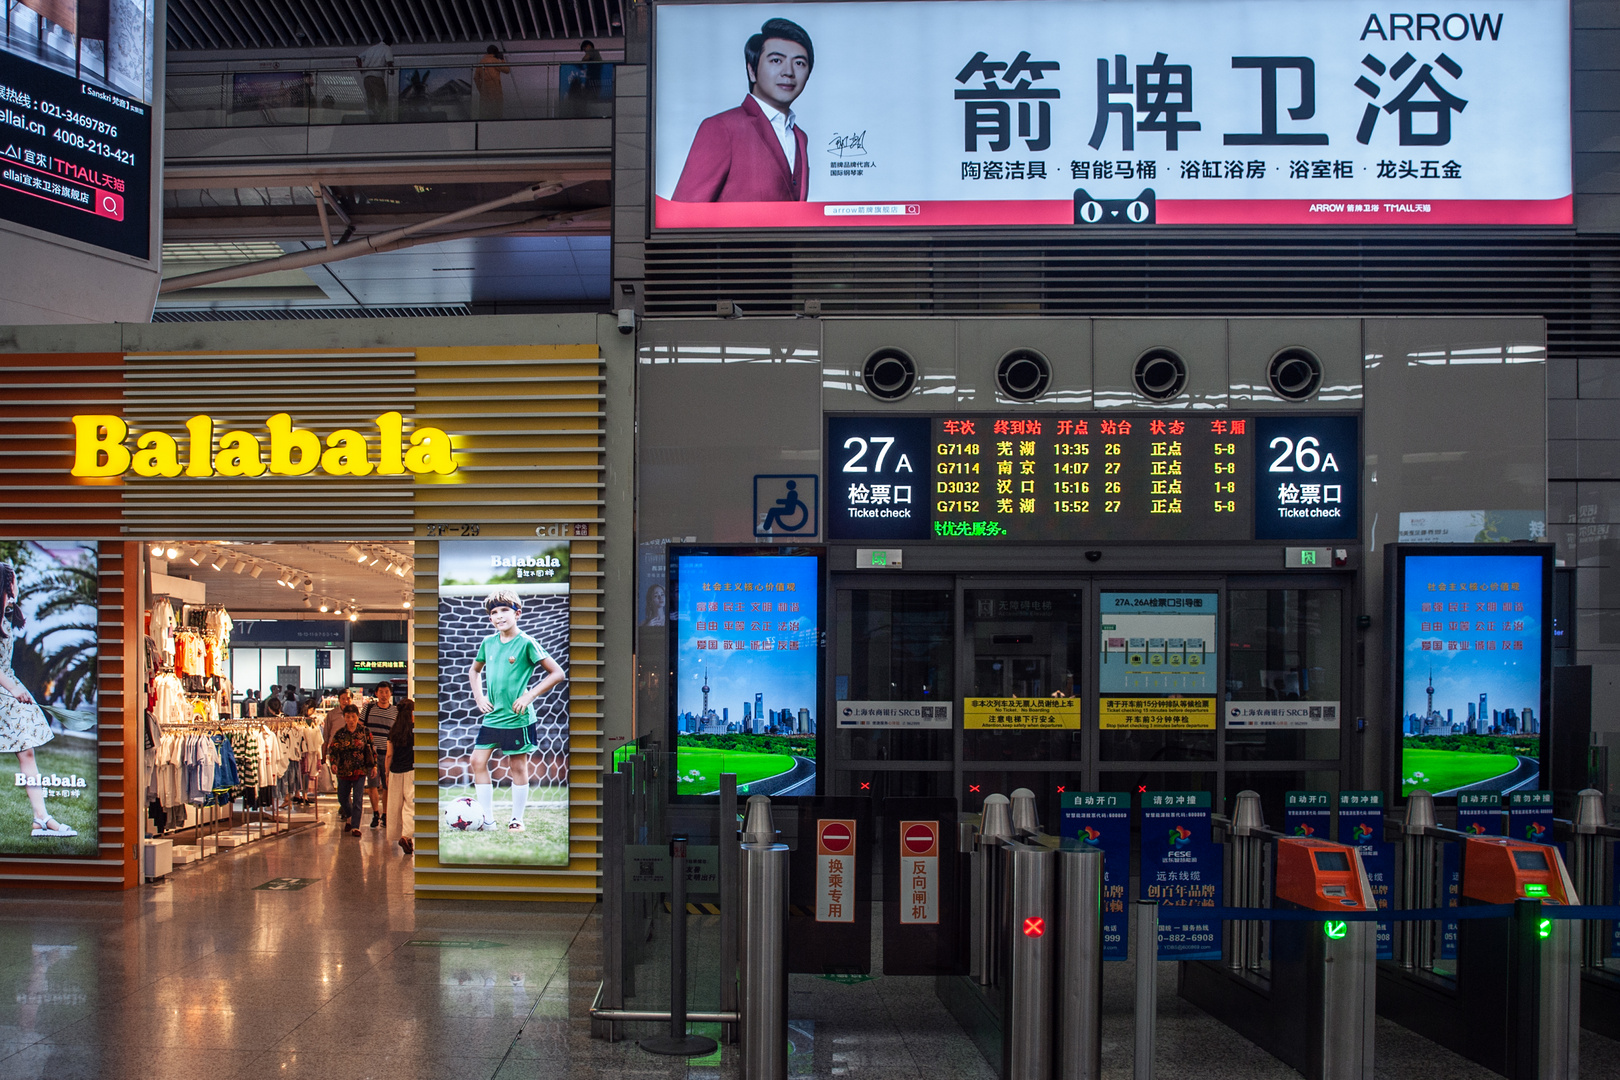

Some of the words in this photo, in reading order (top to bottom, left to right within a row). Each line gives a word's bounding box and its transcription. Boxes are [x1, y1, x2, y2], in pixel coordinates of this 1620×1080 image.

[1359, 13, 1504, 41] ARROW
[954, 50, 1469, 153] 箭牌卫浴
[53, 128, 135, 166] 4008-213-421
[961, 160, 1048, 181] 陶瓷洁具
[1070, 160, 1157, 180] 智能马桶
[1180, 159, 1267, 180] 浴缸浴房
[1289, 159, 1354, 180] 浴室柜
[1376, 159, 1463, 180] 龙头五金
[1309, 204, 1345, 212] ARROW
[944, 420, 976, 435] 车次
[994, 420, 1041, 435] 终到站
[1057, 420, 1089, 435] 开点
[1101, 420, 1132, 435] 站台
[1150, 420, 1185, 435] 状态
[1211, 420, 1246, 435] 车厢
[71, 412, 458, 477] Balabala
[937, 444, 979, 455] G7148
[1054, 444, 1089, 455] 13:35
[1105, 444, 1121, 455] 26
[1151, 441, 1182, 456] 正点
[1214, 444, 1235, 455] 5-8
[937, 463, 979, 474] G7114
[1054, 463, 1089, 474] 14:07
[1105, 463, 1121, 474] 27
[1151, 460, 1182, 475] 正点
[1214, 463, 1235, 474] 5-8
[937, 482, 979, 493] D3032
[1054, 482, 1089, 493] 15:16
[1105, 482, 1121, 493] 26
[1151, 479, 1182, 494] 正点
[1214, 482, 1235, 493] 1-8
[848, 483, 912, 505] 检票口
[1278, 483, 1341, 505] 检票口
[937, 501, 979, 512] G7152
[1054, 501, 1089, 512] 15:52
[1105, 501, 1121, 512] 27
[1151, 498, 1182, 513] 正点
[1214, 501, 1235, 512] 5-8
[848, 507, 879, 518] Ticket
[880, 507, 911, 518] check
[1278, 507, 1309, 518] Ticket
[1310, 507, 1341, 518] check
[426, 523, 480, 537] 2F-29
[491, 555, 561, 567] Balabala
[702, 582, 796, 592] 社会主义核心价值观
[1427, 582, 1520, 592] 社会主义核心价值观
[854, 708, 897, 716] 上海农商银行
[1241, 708, 1285, 716] 上海农商银行
[15, 773, 86, 787] Balabala
[1074, 796, 1117, 805] 自动开门
[1153, 796, 1197, 805] 请勿冲撞
[1289, 795, 1327, 804] 自动开门
[1340, 795, 1379, 804] 请勿冲撞
[1460, 795, 1499, 804] 自动开门
[1513, 794, 1551, 803] 请勿冲撞
[1156, 871, 1200, 881] 远东线缆
[828, 859, 843, 917] 换乘专用
[912, 861, 927, 919] 反向闸机
[1148, 885, 1216, 898] 创百年品牌
